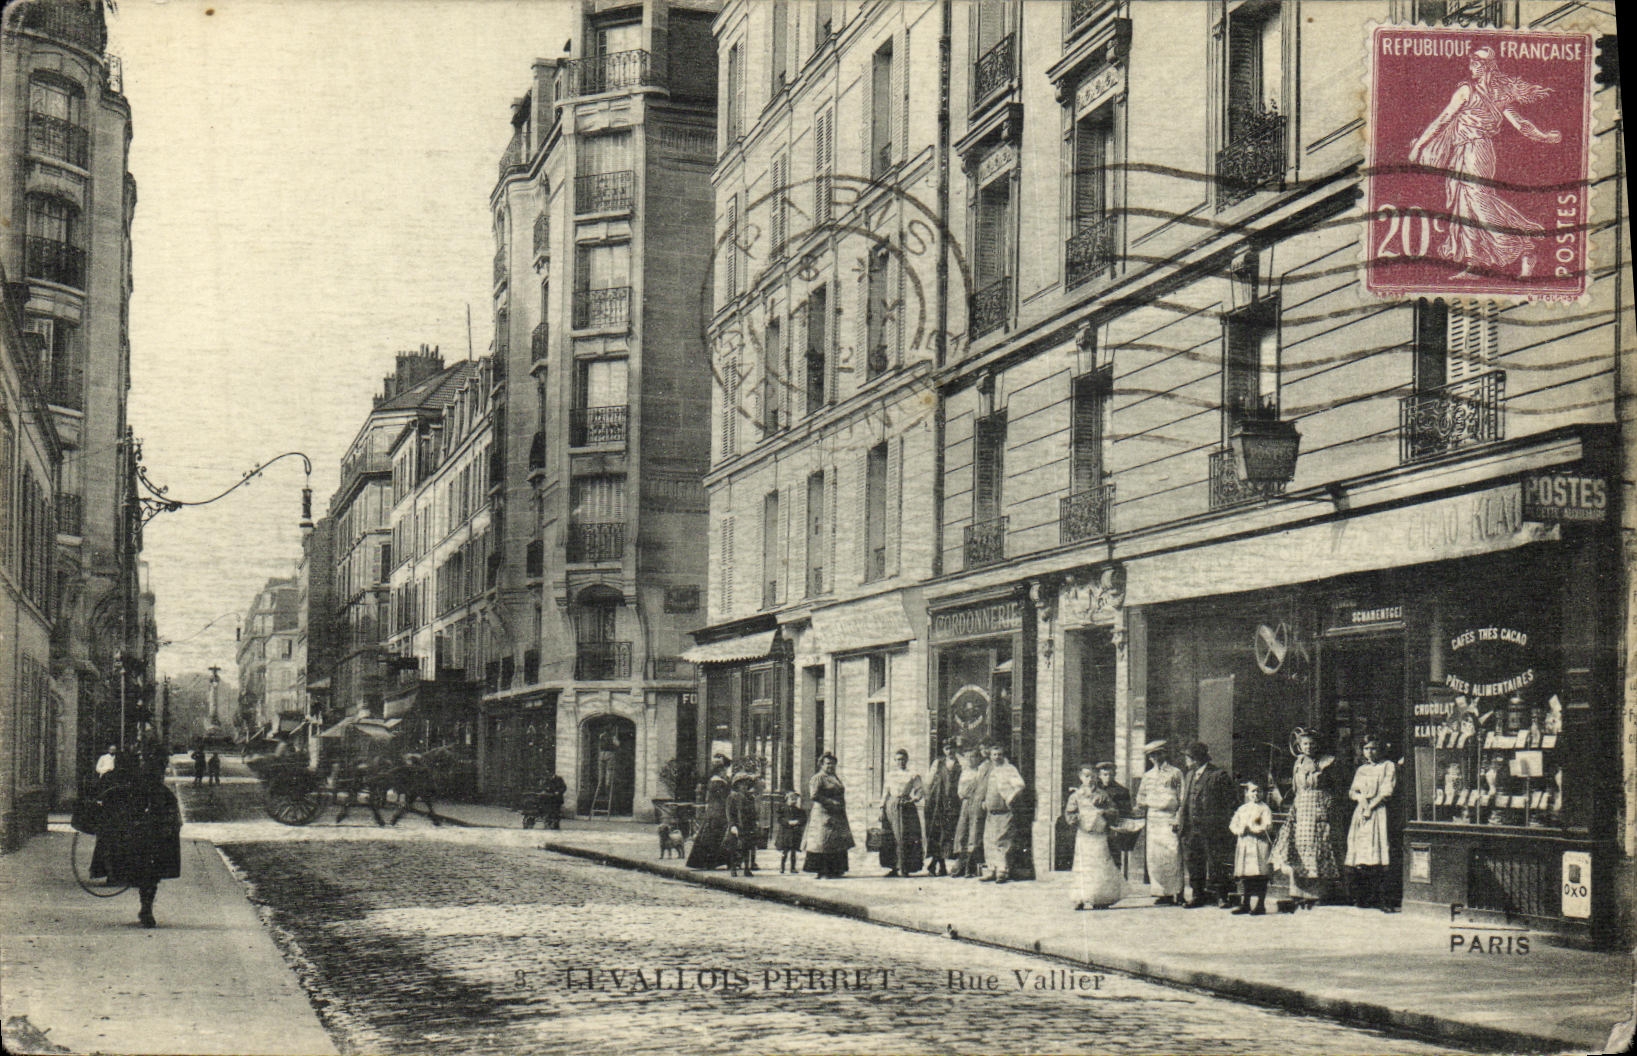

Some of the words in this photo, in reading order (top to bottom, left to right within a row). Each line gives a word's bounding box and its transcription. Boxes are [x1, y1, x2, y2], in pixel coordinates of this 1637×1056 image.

[1500, 41, 1582, 61] FRANÇAISE
[1555, 193, 1577, 278] POSTES
[1525, 476, 1606, 508] POSTES
[935, 602, 1019, 638] CORDONNERIE
[1500, 628, 1527, 646] CACAO
[1472, 668, 1534, 696] ALIMENTAIRES
[1414, 702, 1455, 716] CHOCOLAT
